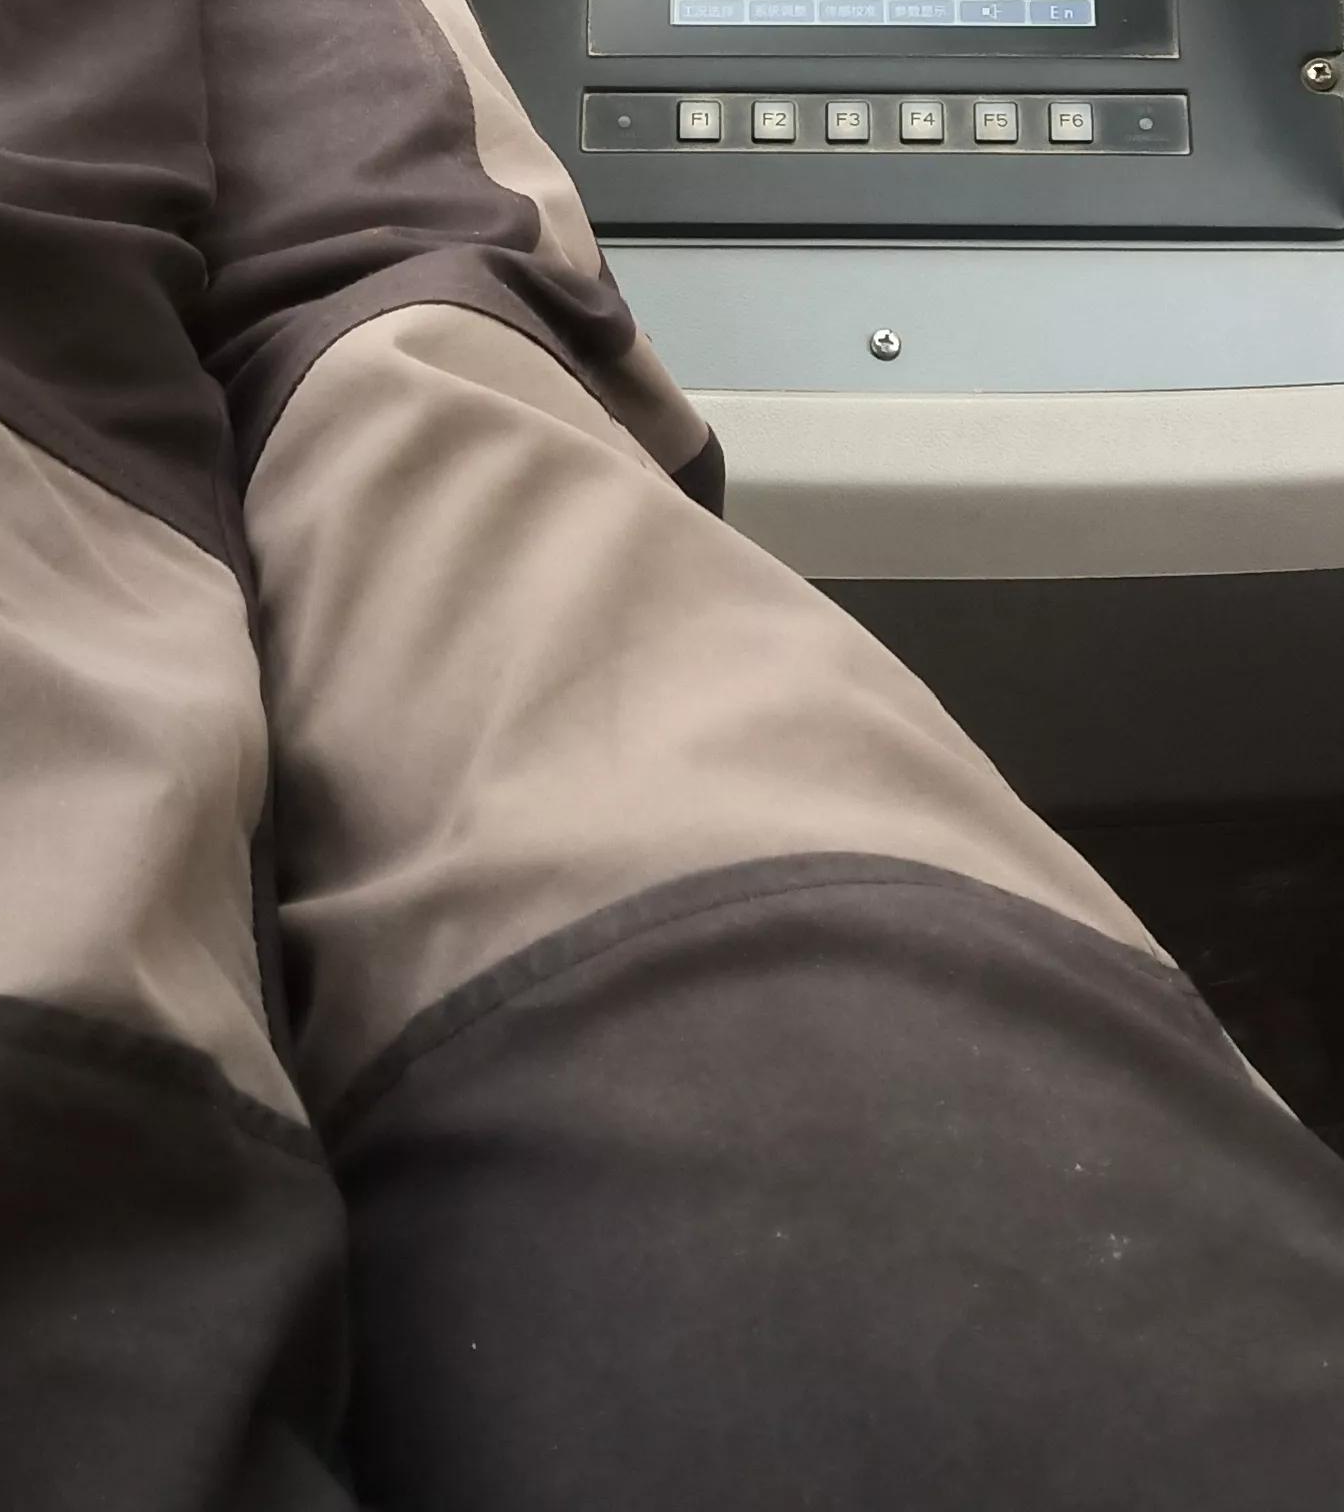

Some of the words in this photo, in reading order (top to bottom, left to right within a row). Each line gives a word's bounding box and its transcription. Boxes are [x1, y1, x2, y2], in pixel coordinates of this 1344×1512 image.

[1050, 5, 1074, 20] En
[691, 114, 710, 126] F1
[762, 114, 786, 126] F2
[836, 114, 860, 126] F3
[910, 112, 936, 126] F4
[984, 114, 1008, 127] F5
[1059, 114, 1084, 127] F6
